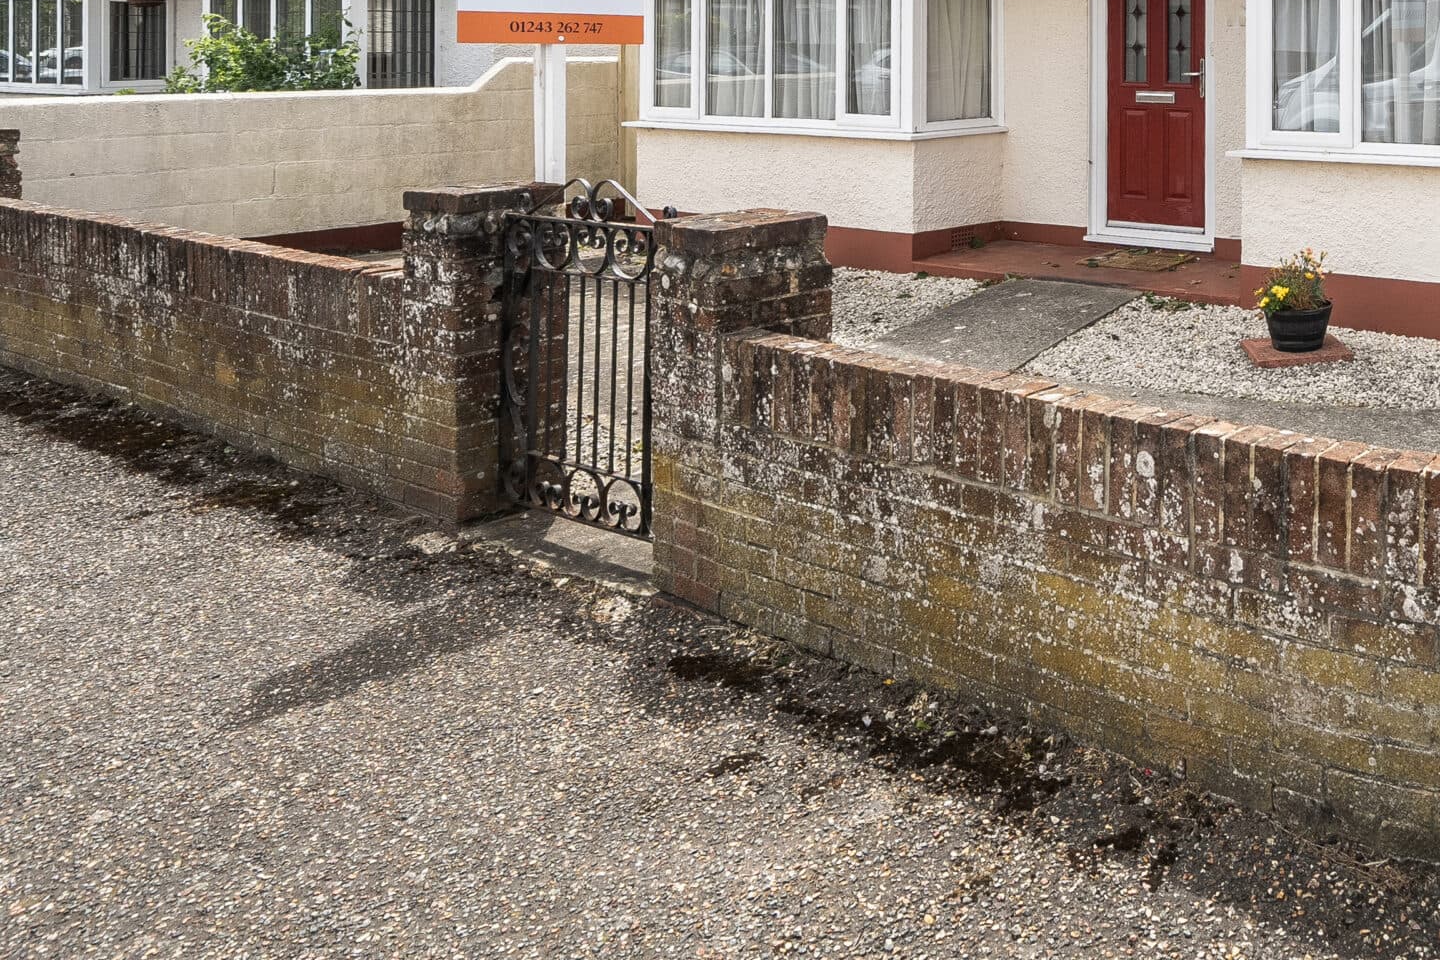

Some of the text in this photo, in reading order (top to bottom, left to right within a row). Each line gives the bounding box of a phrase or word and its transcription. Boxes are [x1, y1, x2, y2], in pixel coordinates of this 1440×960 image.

[509, 20, 603, 33] 01243 262 747
